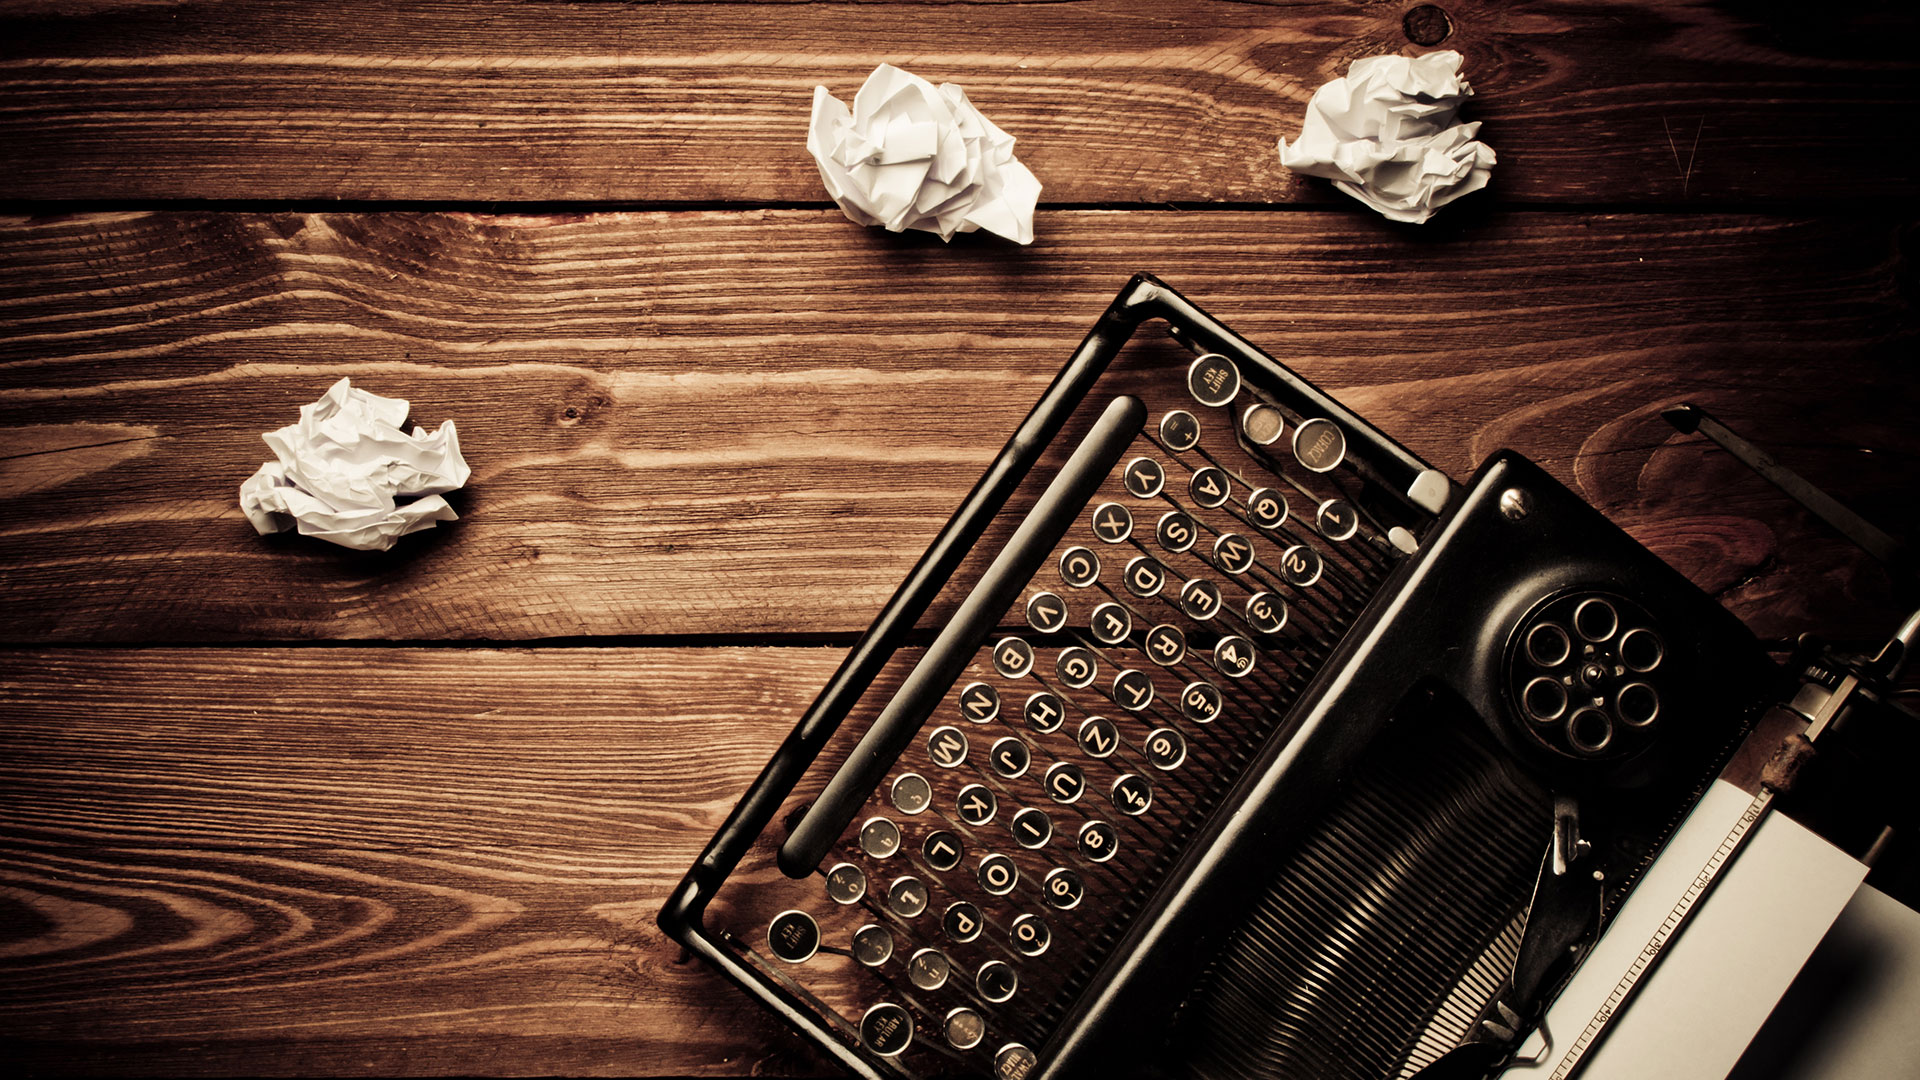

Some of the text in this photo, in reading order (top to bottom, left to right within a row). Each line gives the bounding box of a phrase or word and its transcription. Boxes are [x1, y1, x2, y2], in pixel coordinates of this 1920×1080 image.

[1203, 367, 1217, 384] KEY
[1207, 369, 1228, 394] SHIFT
[1134, 470, 1156, 490] Y
[1198, 475, 1221, 496] A
[1253, 498, 1279, 519] Q
[1324, 510, 1340, 524] 1
[1099, 511, 1125, 536] X
[1166, 522, 1188, 543] S
[1219, 540, 1248, 570] W
[1286, 553, 1306, 573] 2
[1068, 556, 1090, 578] C
[1134, 566, 1157, 589] D
[1188, 587, 1213, 611] E
[1036, 605, 1058, 625] V
[1253, 601, 1272, 619] 3
[1105, 613, 1124, 637] F
[1153, 634, 1178, 656] R
[1221, 644, 1237, 663] 4
[1001, 646, 1025, 669] B
[1064, 657, 1088, 679] G
[1233, 656, 1249, 669] @
[966, 691, 992, 717] N
[1123, 683, 1146, 704] T
[1187, 690, 1206, 710] 5
[1030, 701, 1057, 727] H
[1084, 725, 1110, 752] Z
[1152, 738, 1171, 756] 6
[933, 734, 962, 765] M
[1000, 750, 1017, 770] J
[1052, 772, 1077, 796] U
[1121, 786, 1138, 804] 7
[1134, 796, 1146, 811] &
[962, 794, 988, 818] K
[1021, 821, 1040, 837] I
[1084, 829, 1103, 848] 8
[930, 840, 956, 855] L
[987, 864, 1009, 886] O
[1698, 875, 1709, 888] 20
[1051, 877, 1069, 896] 9
[780, 923, 795, 939] KEY
[956, 911, 975, 933] P
[785, 925, 806, 949] SHIFT
[1649, 942, 1661, 955] 30
[873, 1015, 888, 1032] KEY
[1599, 1008, 1611, 1022] 40
